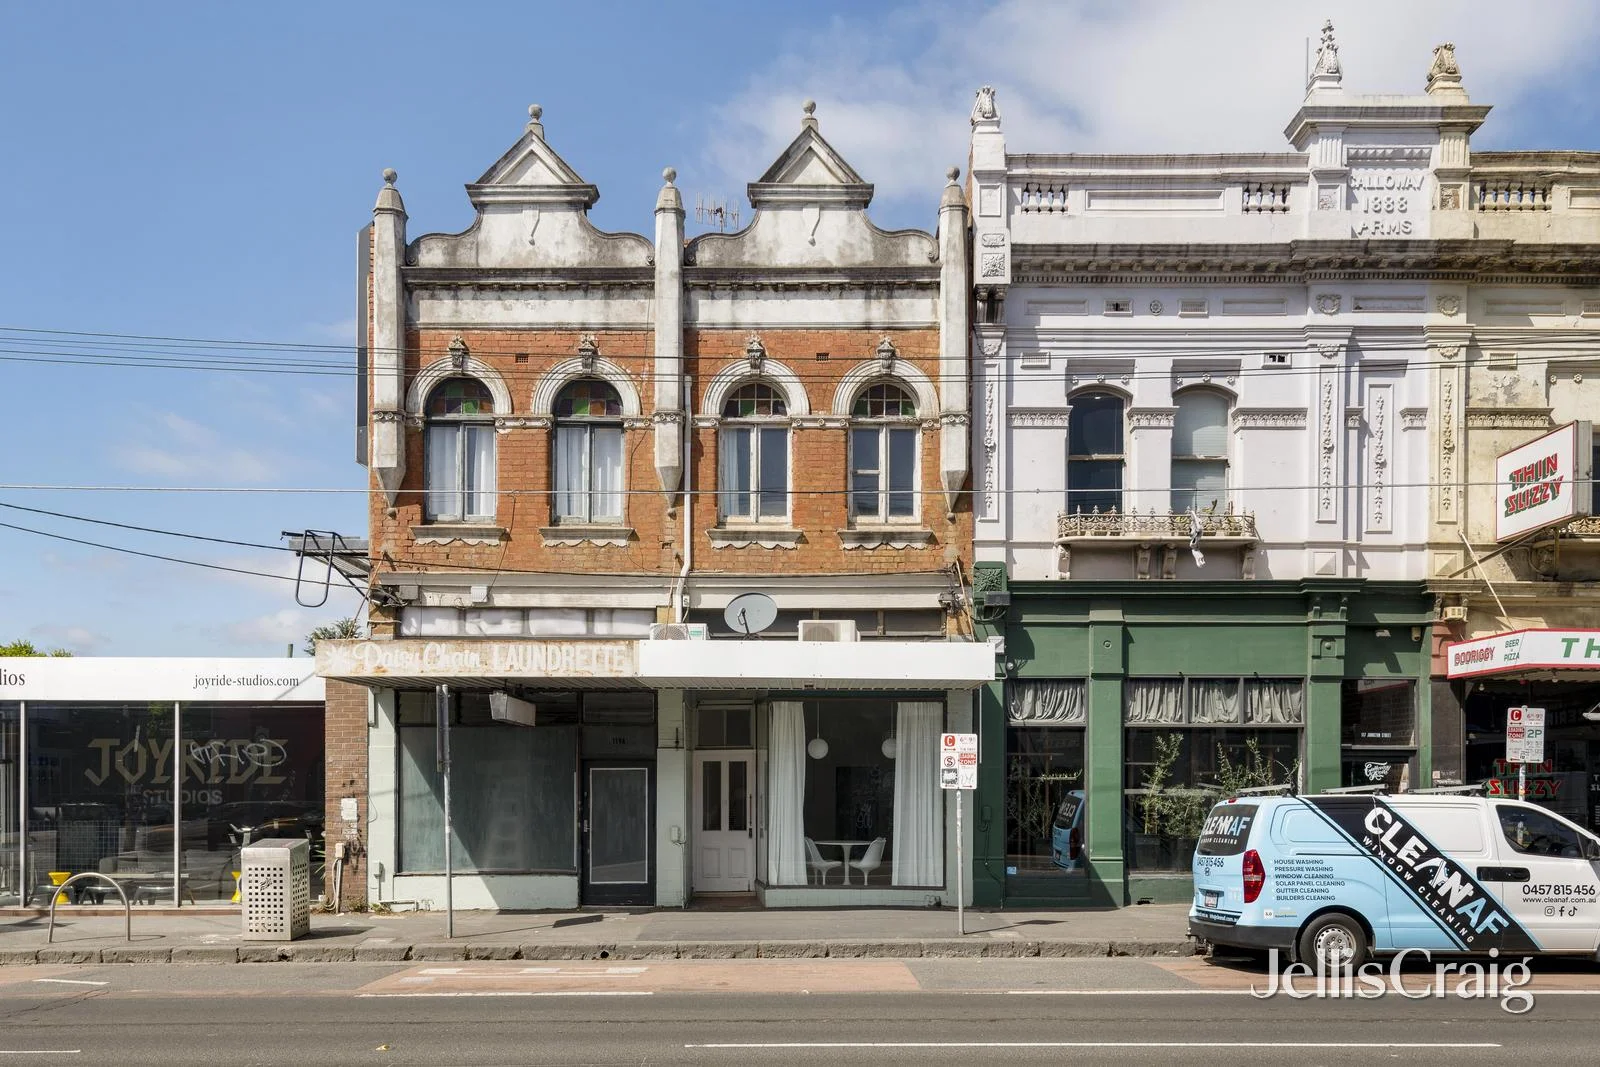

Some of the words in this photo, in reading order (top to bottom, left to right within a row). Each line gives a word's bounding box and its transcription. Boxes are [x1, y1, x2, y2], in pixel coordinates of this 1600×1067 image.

[1363, 196, 1408, 213] 1888
[1358, 220, 1413, 236] ARMS
[1508, 453, 1558, 492] THIN
[1504, 475, 1563, 517] SLIZZY
[1505, 638, 1520, 648] BEER
[493, 644, 627, 673] LAUNDRETTE
[1454, 646, 1496, 666] BODRIGGY
[1504, 652, 1520, 662] PIZZA
[193, 674, 299, 690] joyride-studios.com
[1527, 729, 1543, 739] 2P
[84, 738, 289, 786] JOYRIDE
[1363, 835, 1414, 881] WINDOW
[1418, 886, 1475, 943] CLEANING
[1522, 884, 1552, 895] 0457
[1553, 884, 1572, 895] 815
[1573, 884, 1596, 895] 456
[1522, 896, 1597, 904] www.cleanaf.com.au
